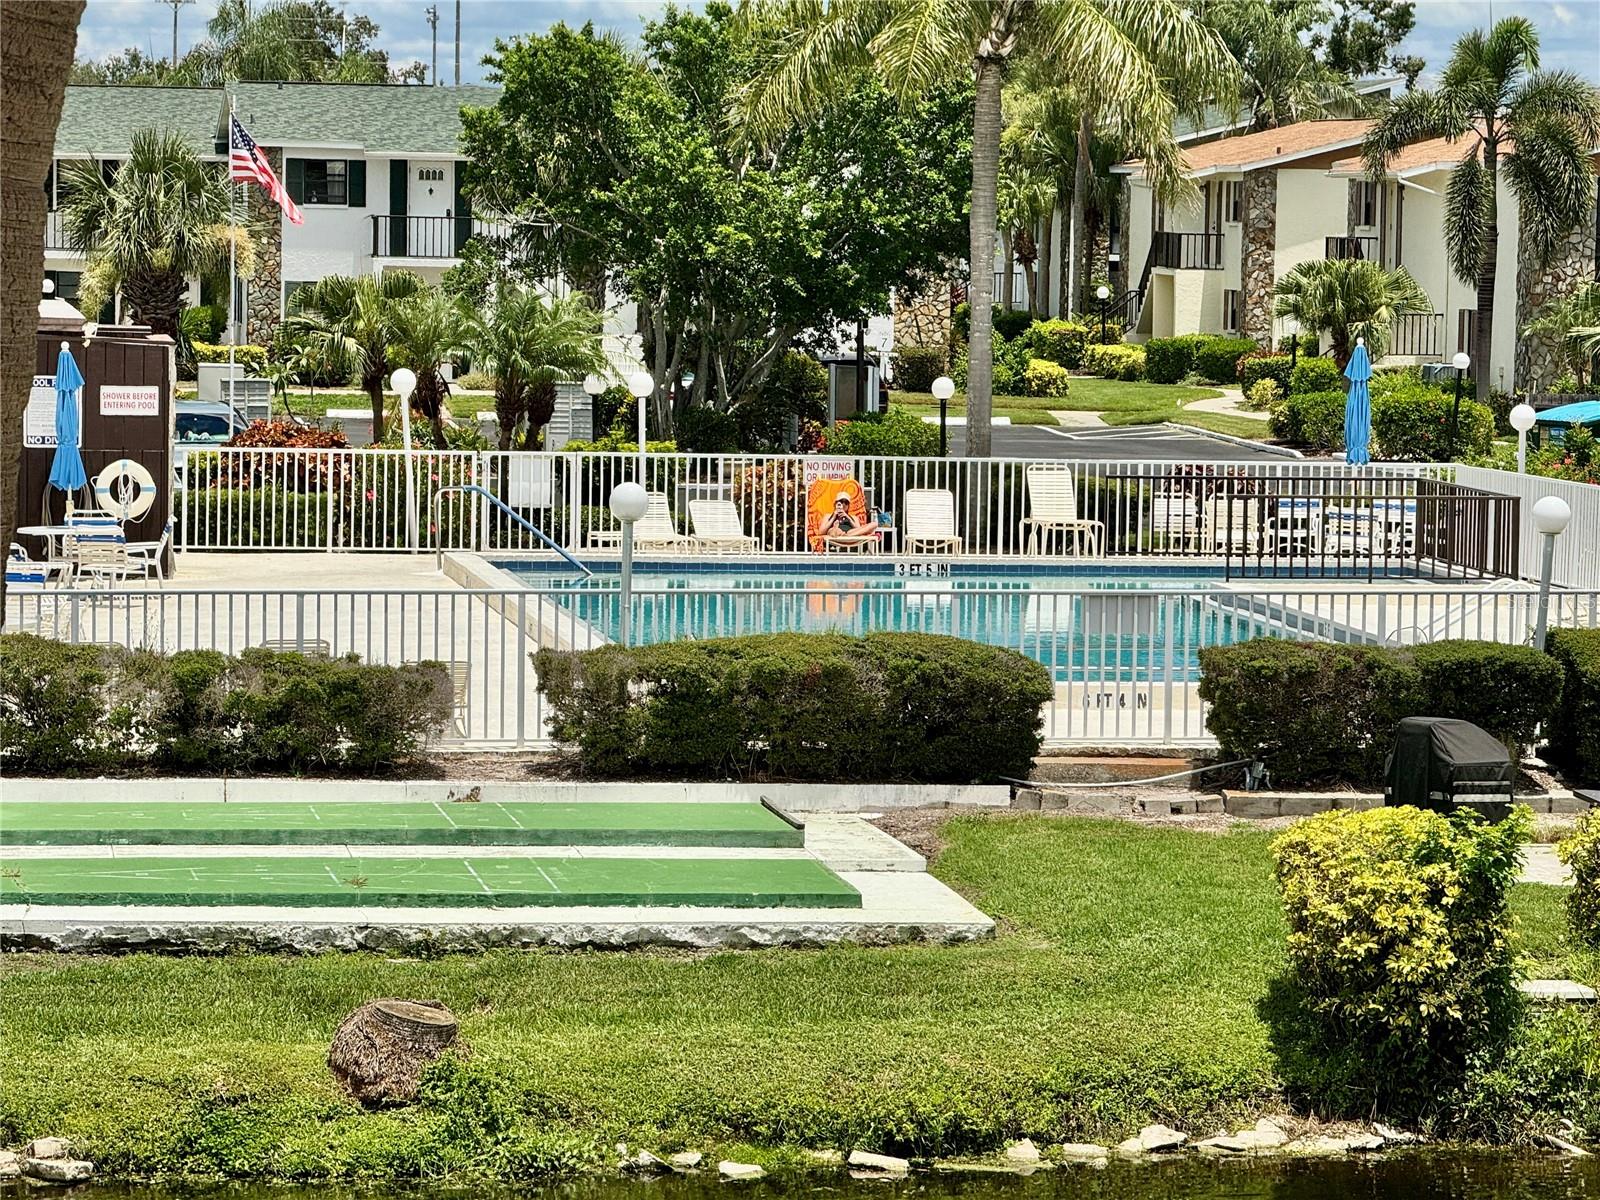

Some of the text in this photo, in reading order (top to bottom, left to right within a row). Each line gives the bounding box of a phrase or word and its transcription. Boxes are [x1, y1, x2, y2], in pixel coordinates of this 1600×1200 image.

[32, 378, 51, 387] OOL
[102, 392, 157, 400] SHOWER BEFORE
[103, 401, 156, 409] ENTERING POOL
[27, 436, 42, 445] NO
[806, 462, 851, 471] NO DIVING
[806, 473, 817, 482] OR
[899, 563, 905, 576] 3
[926, 563, 932, 576] 5
[937, 563, 948, 577] IN
